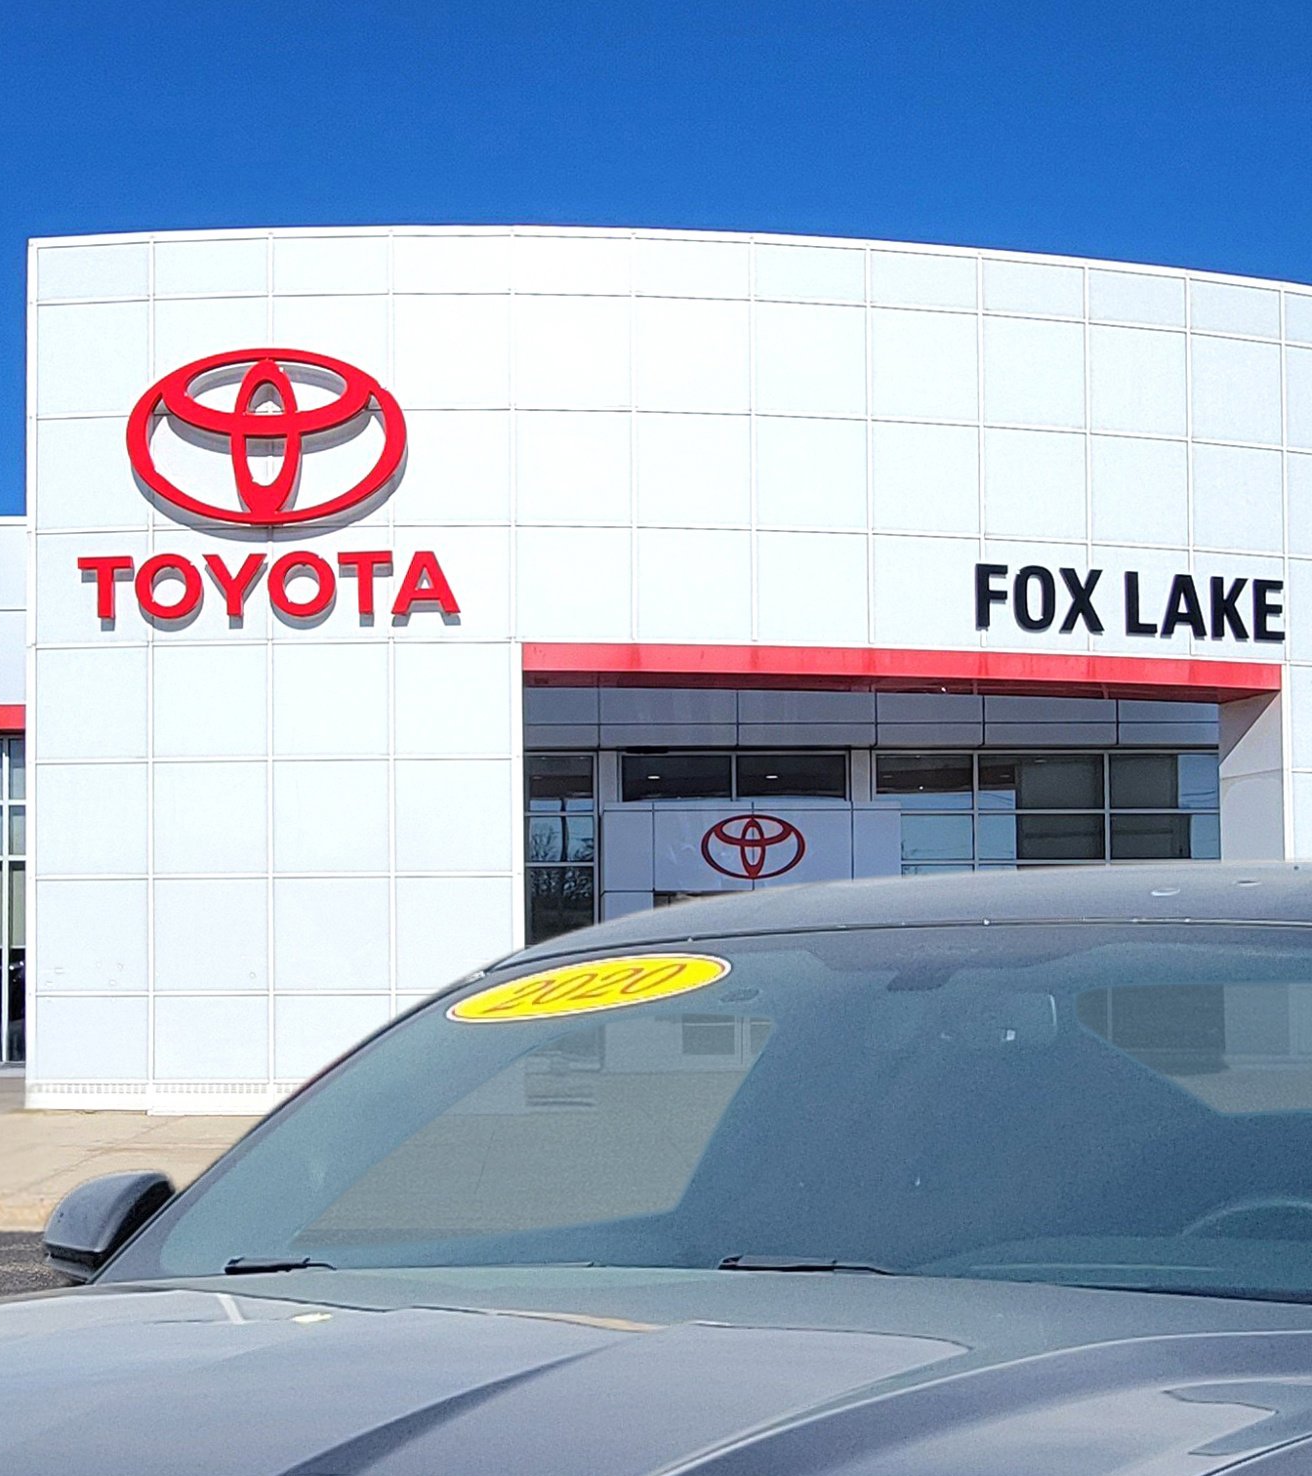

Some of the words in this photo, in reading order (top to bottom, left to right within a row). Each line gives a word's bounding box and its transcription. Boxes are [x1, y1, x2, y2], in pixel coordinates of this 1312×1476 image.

[77, 550, 461, 624] TOYOTA
[974, 562, 1104, 635] FOX
[1124, 570, 1286, 643] LAKE
[482, 963, 687, 1014] 2020
